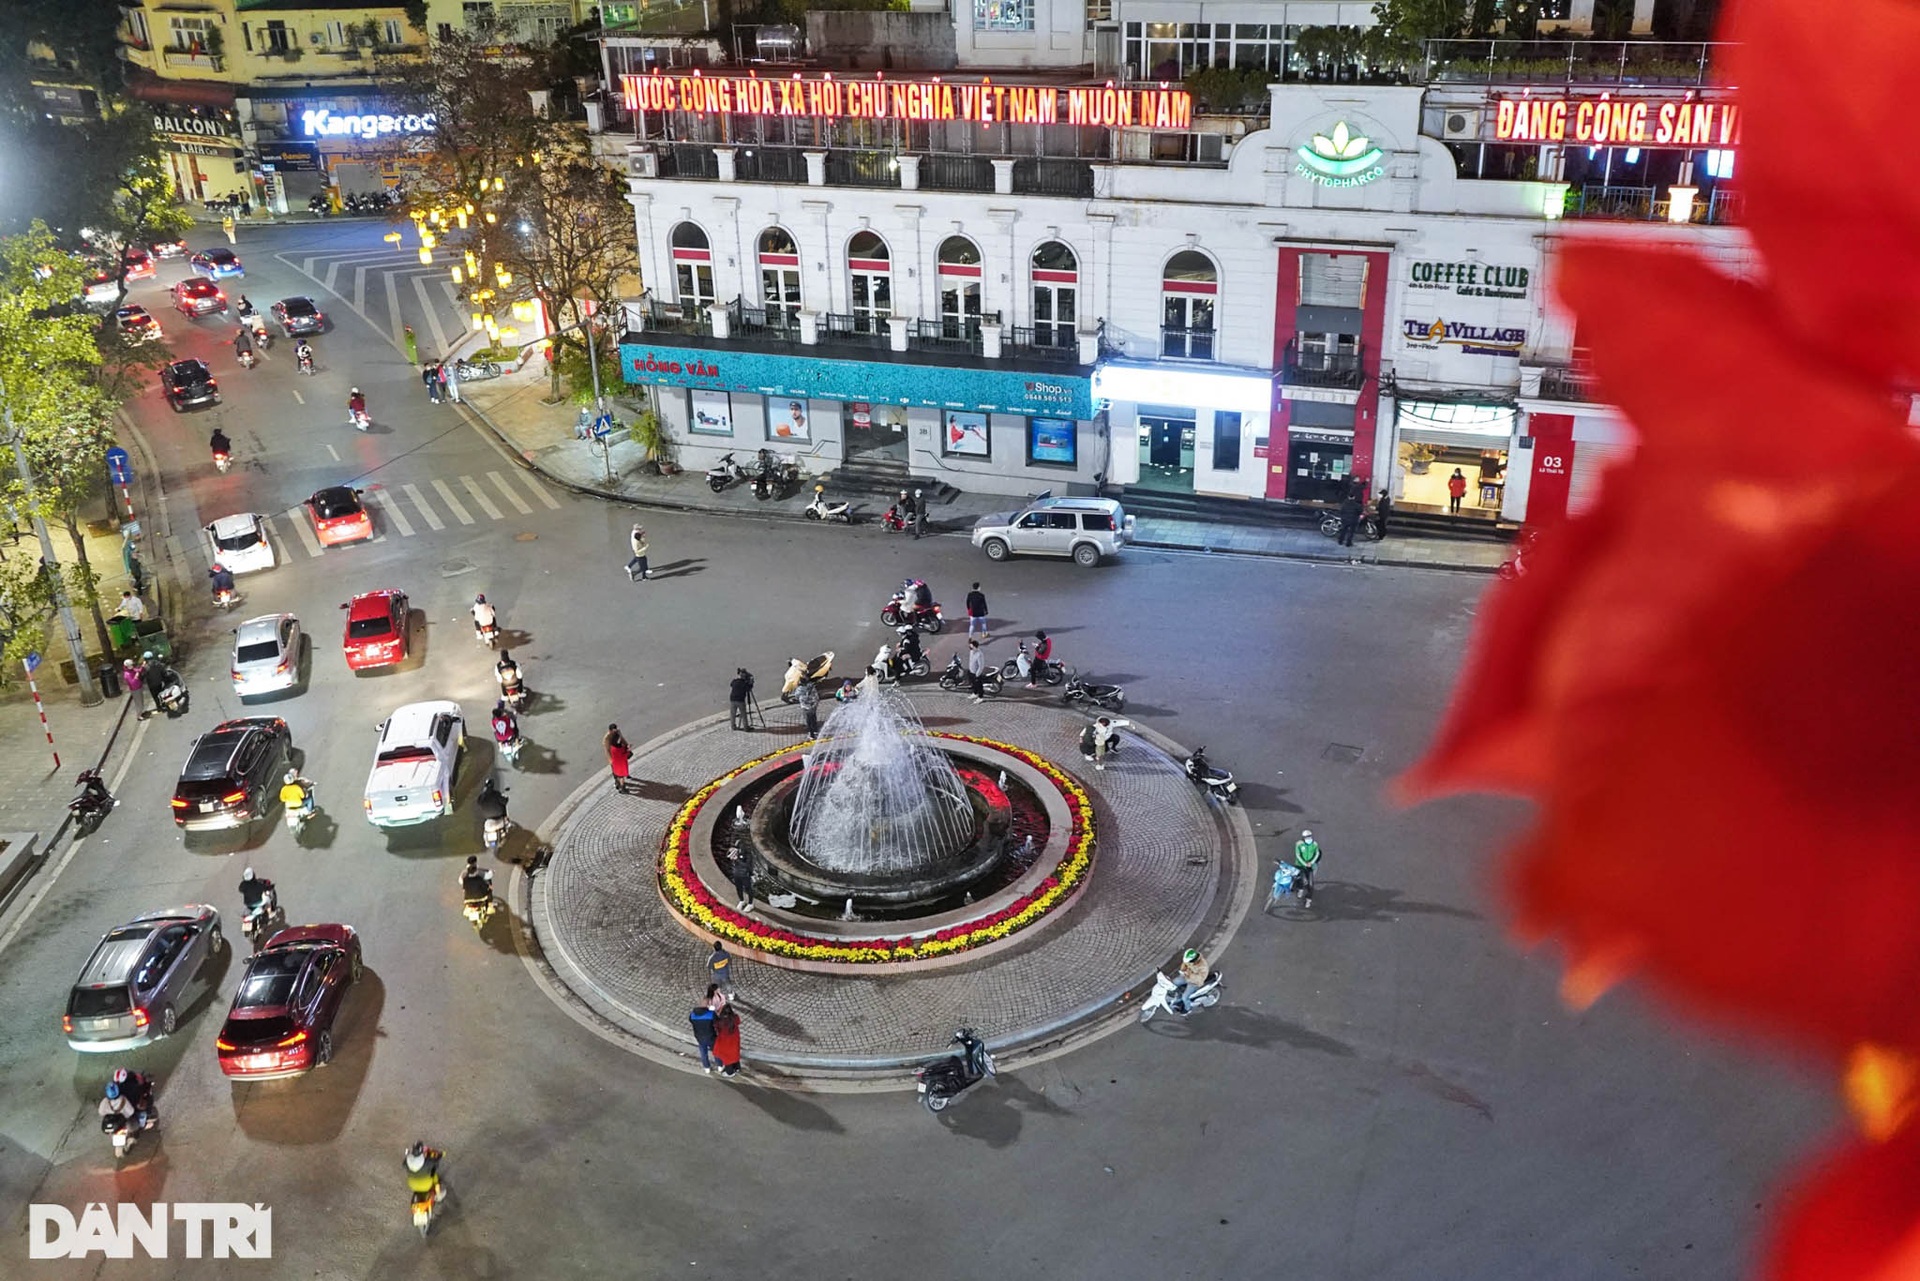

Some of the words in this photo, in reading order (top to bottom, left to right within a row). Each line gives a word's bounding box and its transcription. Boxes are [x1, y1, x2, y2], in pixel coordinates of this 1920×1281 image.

[622, 67, 676, 111] NƯỚC
[679, 69, 732, 120] CỘNG
[735, 69, 775, 115] HÒA
[779, 73, 807, 116] XÃ
[809, 72, 842, 124] HỘI
[846, 71, 887, 118] CHỦ
[891, 76, 956, 121] NGHĨA
[961, 76, 1005, 129] VIỆT
[1009, 87, 1057, 125] NAM
[1068, 80, 1133, 126] MUÔN
[1140, 81, 1192, 129] NĂM
[153, 116, 226, 136] BALCONY
[1495, 87, 1568, 141] ĐẢNG
[1574, 91, 1648, 150] CỘNG
[1654, 91, 1714, 144] SẢN
[1294, 163, 1384, 188] PHYTOPHARCO
[1411, 262, 1478, 284] COFFEE
[1484, 265, 1530, 288] CLUB
[633, 352, 682, 374] HỒNG
[686, 360, 720, 377] VÂN
[1543, 456, 1562, 468] 03
